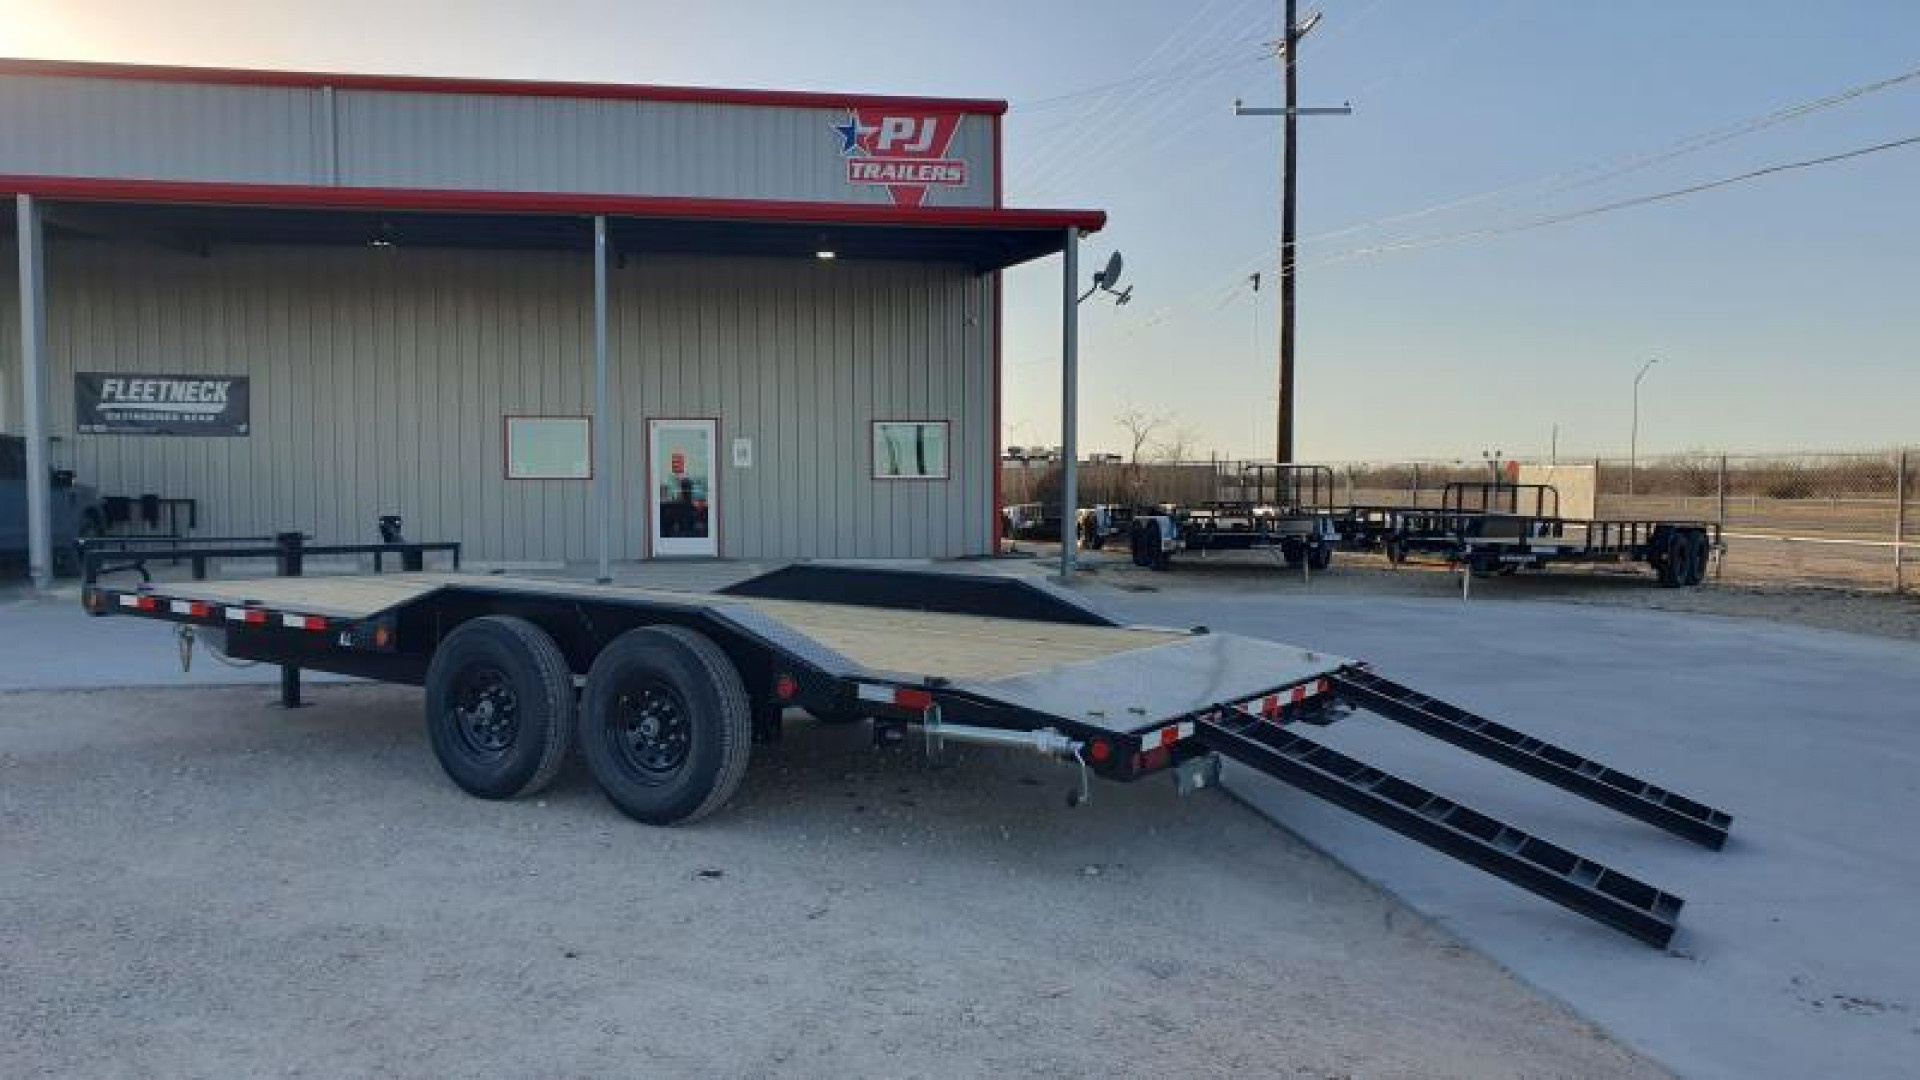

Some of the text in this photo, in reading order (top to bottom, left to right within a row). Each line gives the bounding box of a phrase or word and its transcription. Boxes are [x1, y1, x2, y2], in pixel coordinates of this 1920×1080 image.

[876, 117, 937, 151] PJ
[851, 162, 961, 181] TRAILERS
[101, 379, 231, 402] FLEETNECK
